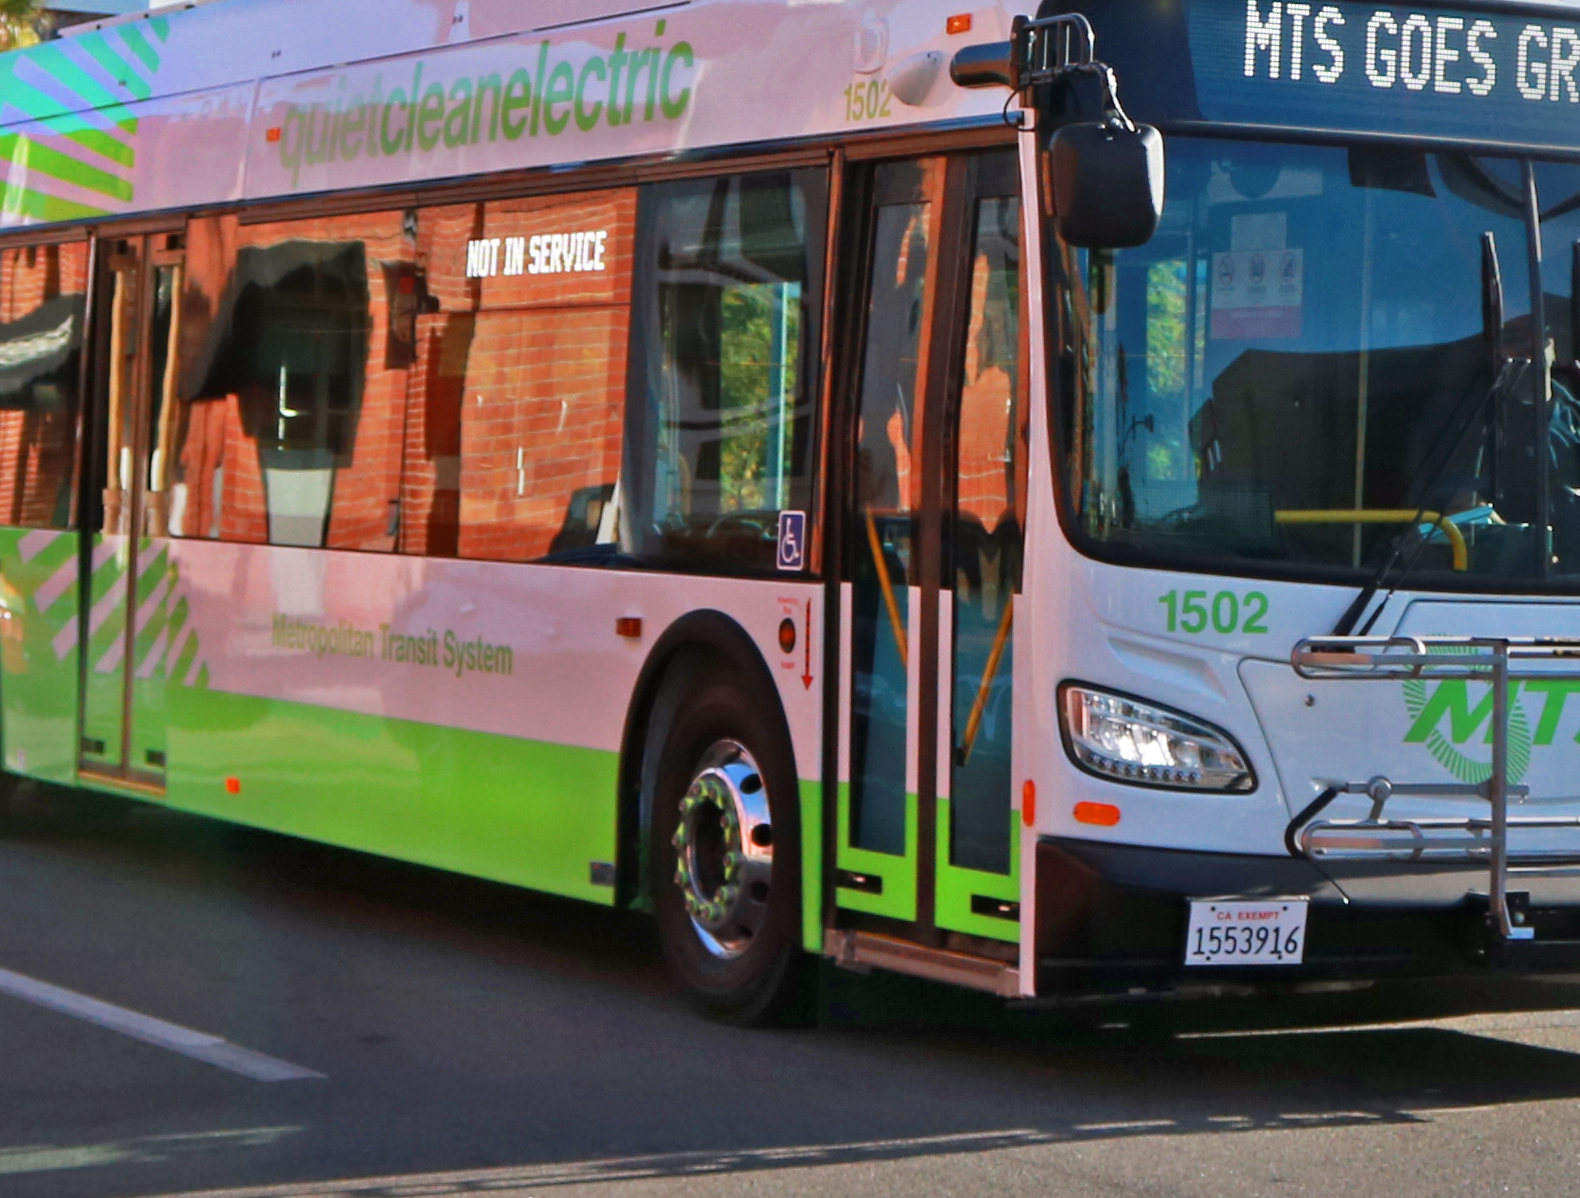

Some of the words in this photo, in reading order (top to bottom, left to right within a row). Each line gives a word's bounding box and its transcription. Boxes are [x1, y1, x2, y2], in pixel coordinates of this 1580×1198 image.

[1243, 0, 1345, 83] MTS
[1365, 10, 1498, 96] GOES
[279, 19, 694, 188] quietcleanelectric
[843, 80, 893, 121] 1502
[466, 238, 501, 278] NOT
[503, 236, 525, 276] IN
[528, 230, 608, 274] SERVICE
[1158, 590, 1269, 634] 1502
[272, 613, 374, 660] Metropolitan
[379, 623, 439, 666] Transit
[443, 629, 514, 678] System
[1217, 911, 1232, 921] CA
[1238, 911, 1280, 921] EXEMPT
[1192, 925, 1300, 956] 1553916
